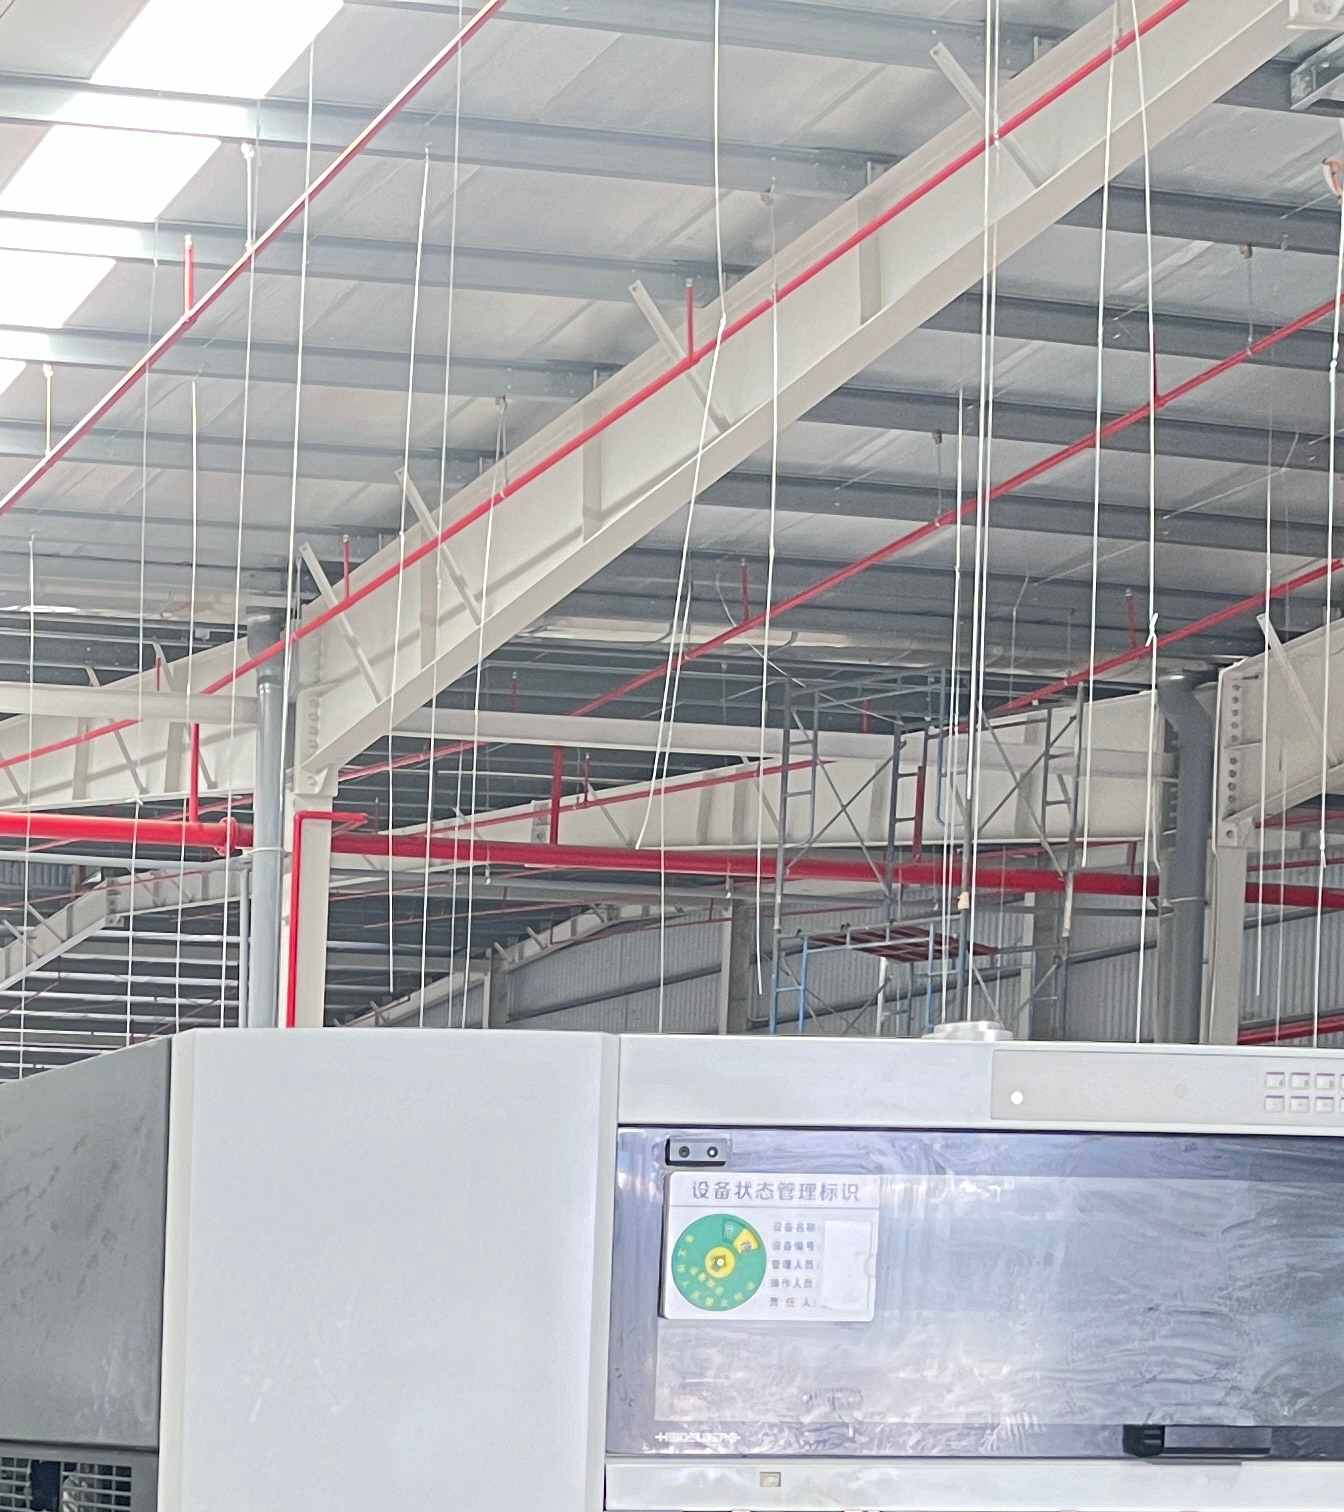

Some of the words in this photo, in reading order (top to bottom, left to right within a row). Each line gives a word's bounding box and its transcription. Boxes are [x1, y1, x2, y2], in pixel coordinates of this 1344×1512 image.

[691, 1180, 860, 1202] 设备状态管理标识
